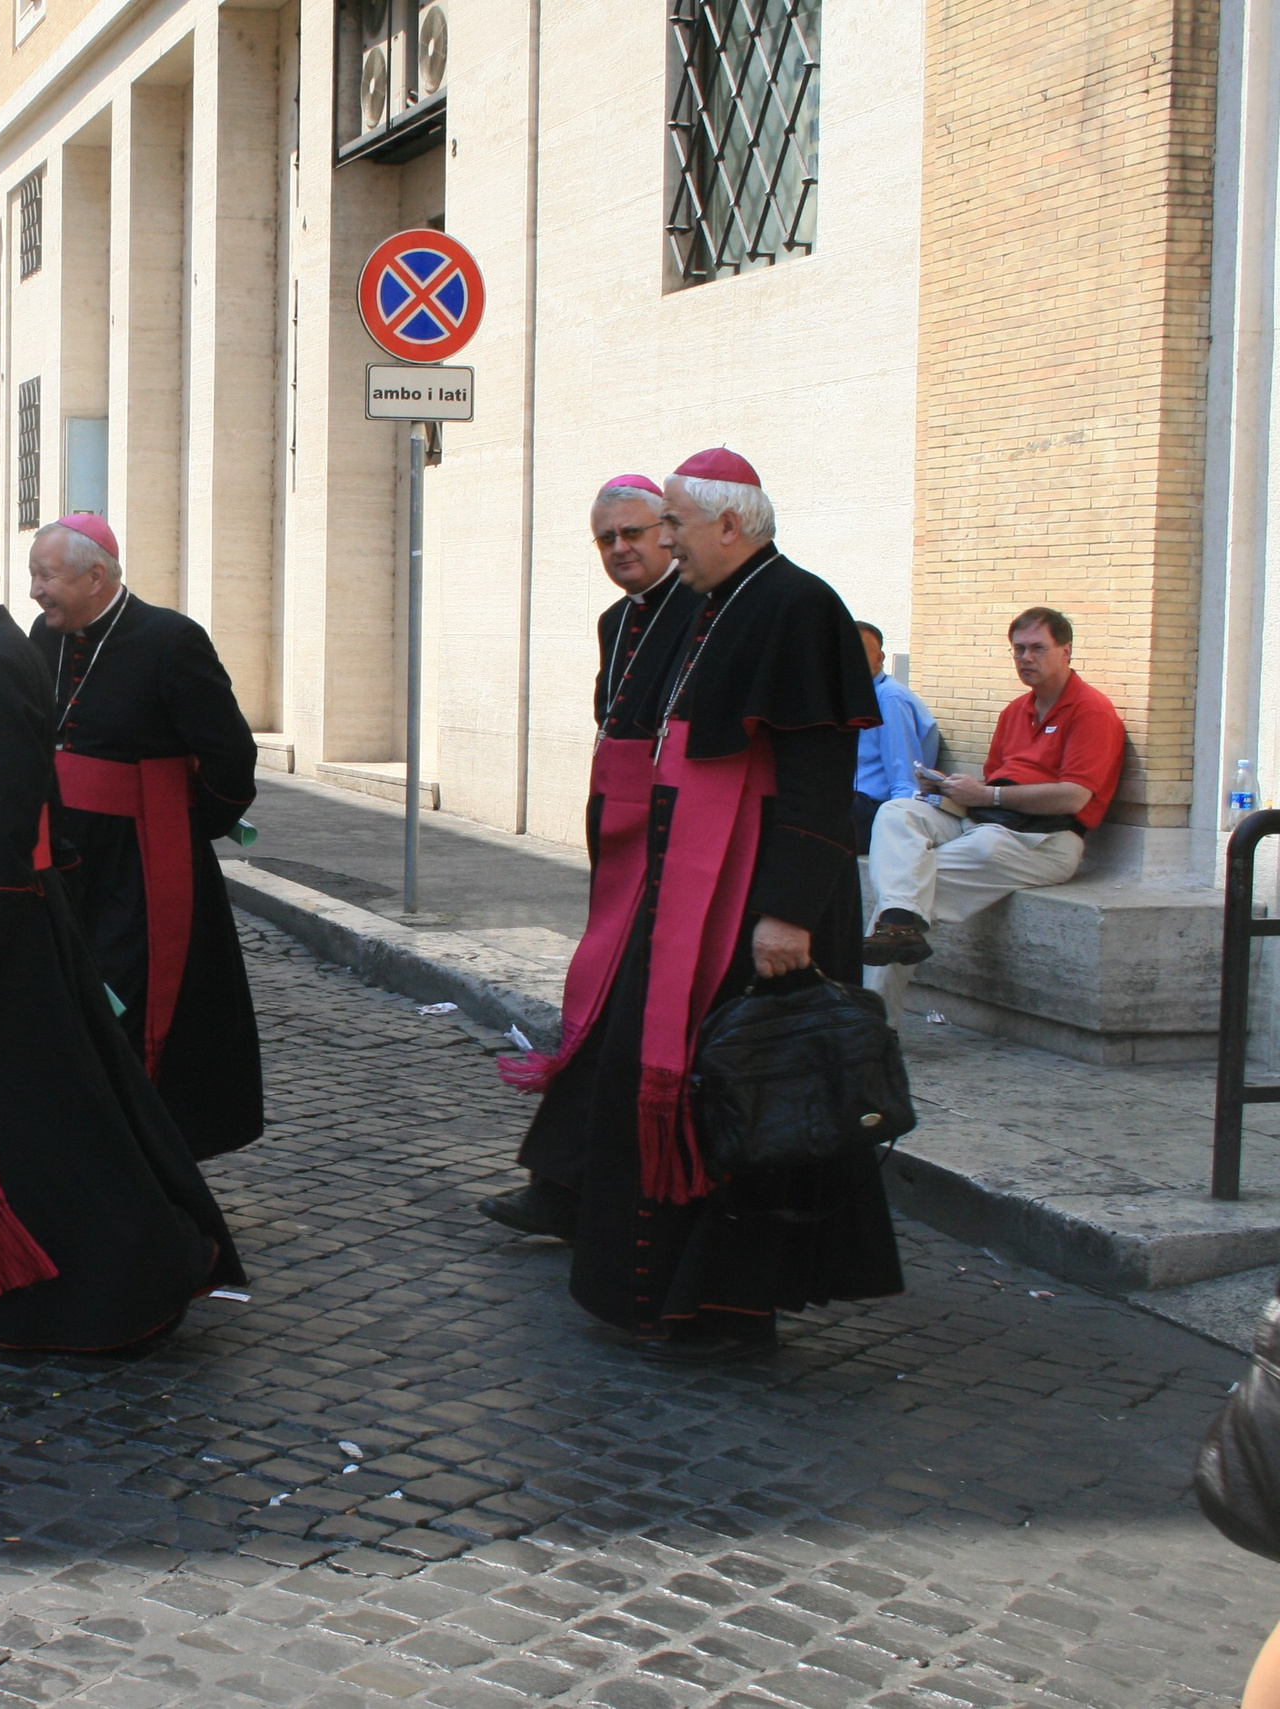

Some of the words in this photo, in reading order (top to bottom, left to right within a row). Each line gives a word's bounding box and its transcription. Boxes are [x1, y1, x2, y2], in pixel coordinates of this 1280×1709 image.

[372, 386, 422, 401] ambo
[428, 388, 432, 400] i
[438, 387, 468, 402] lati
